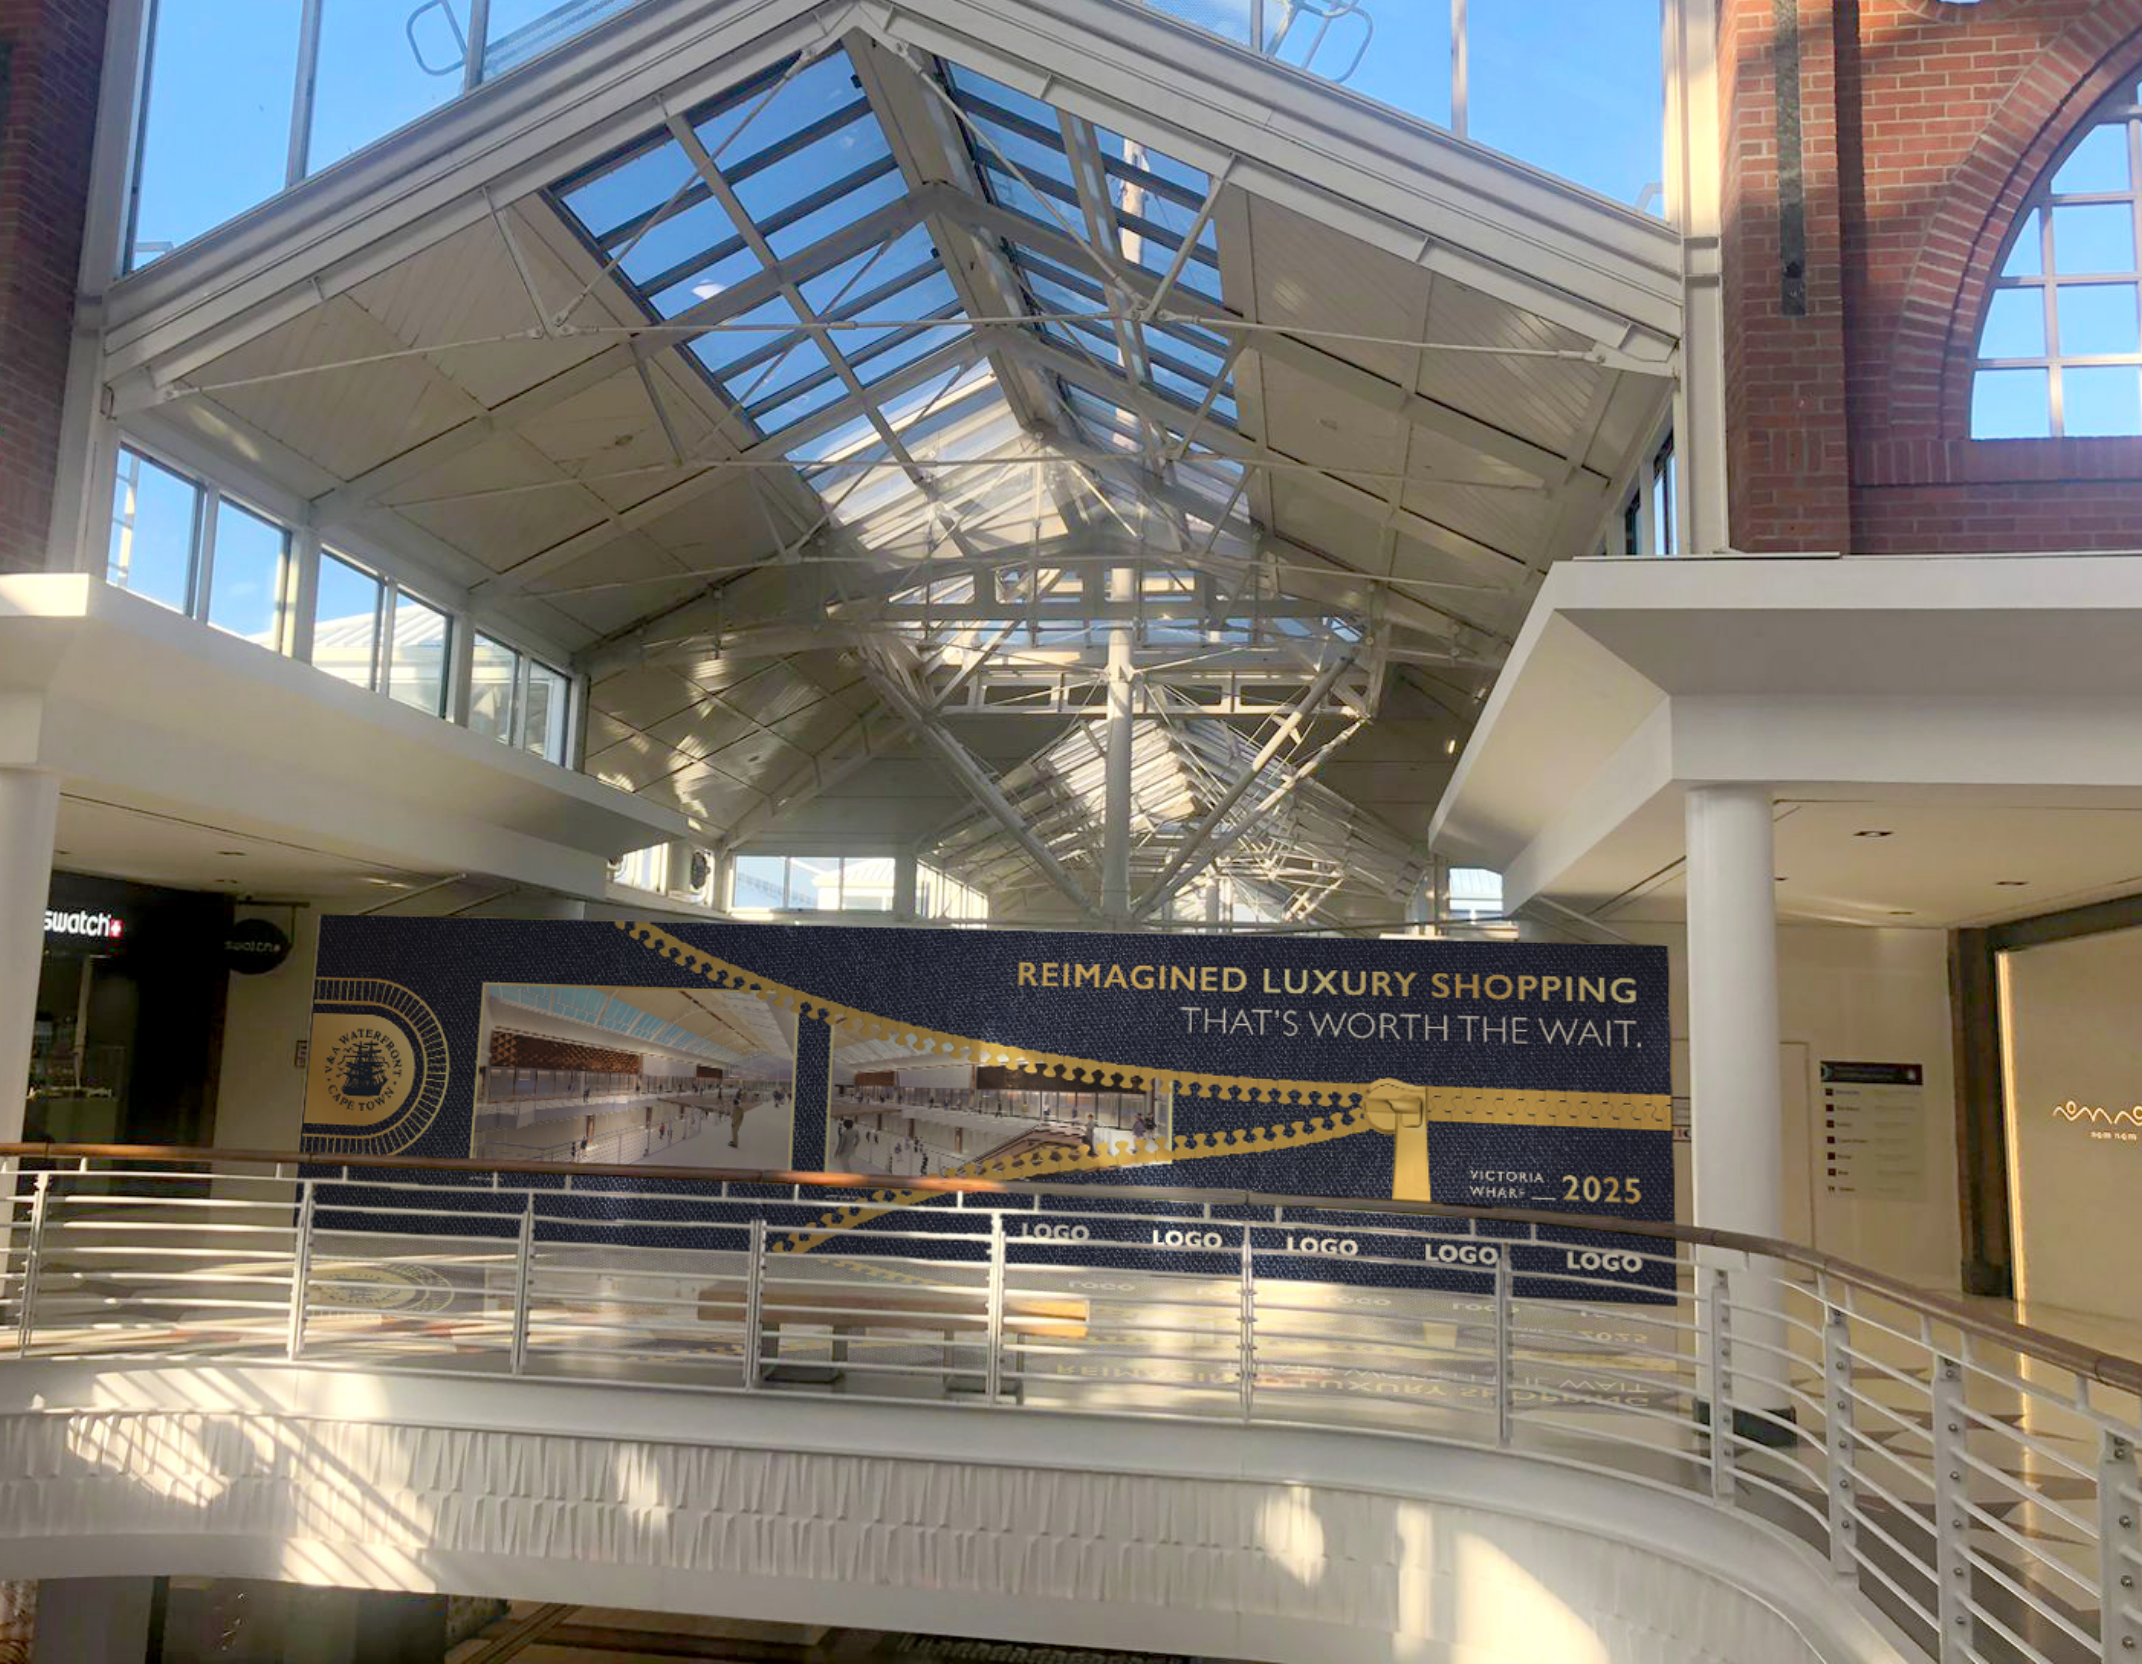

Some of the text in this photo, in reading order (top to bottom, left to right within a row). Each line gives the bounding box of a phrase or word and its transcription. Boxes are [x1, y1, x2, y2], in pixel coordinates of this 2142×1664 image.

[44, 910, 111, 936] swatch
[1018, 962, 1637, 1003] REIMAGINED LUXURY SHOPPING
[1180, 1006, 1642, 1047] THAT'S WORTH THE WAIT.
[325, 1028, 402, 1078] V&A WATERFRONT
[328, 1084, 395, 1111] CAPE TOWN
[2114, 1132, 2137, 1141] nom
[1470, 1170, 1545, 1183] VICTORIA
[1470, 1175, 1642, 1204] WHARF 2025
[1022, 1222, 1090, 1240] LOGO
[1152, 1230, 1222, 1248] LOGO
[1287, 1237, 1358, 1256] LOGO
[1425, 1244, 1499, 1265] LOGO
[1566, 1251, 1643, 1273] LOGO
